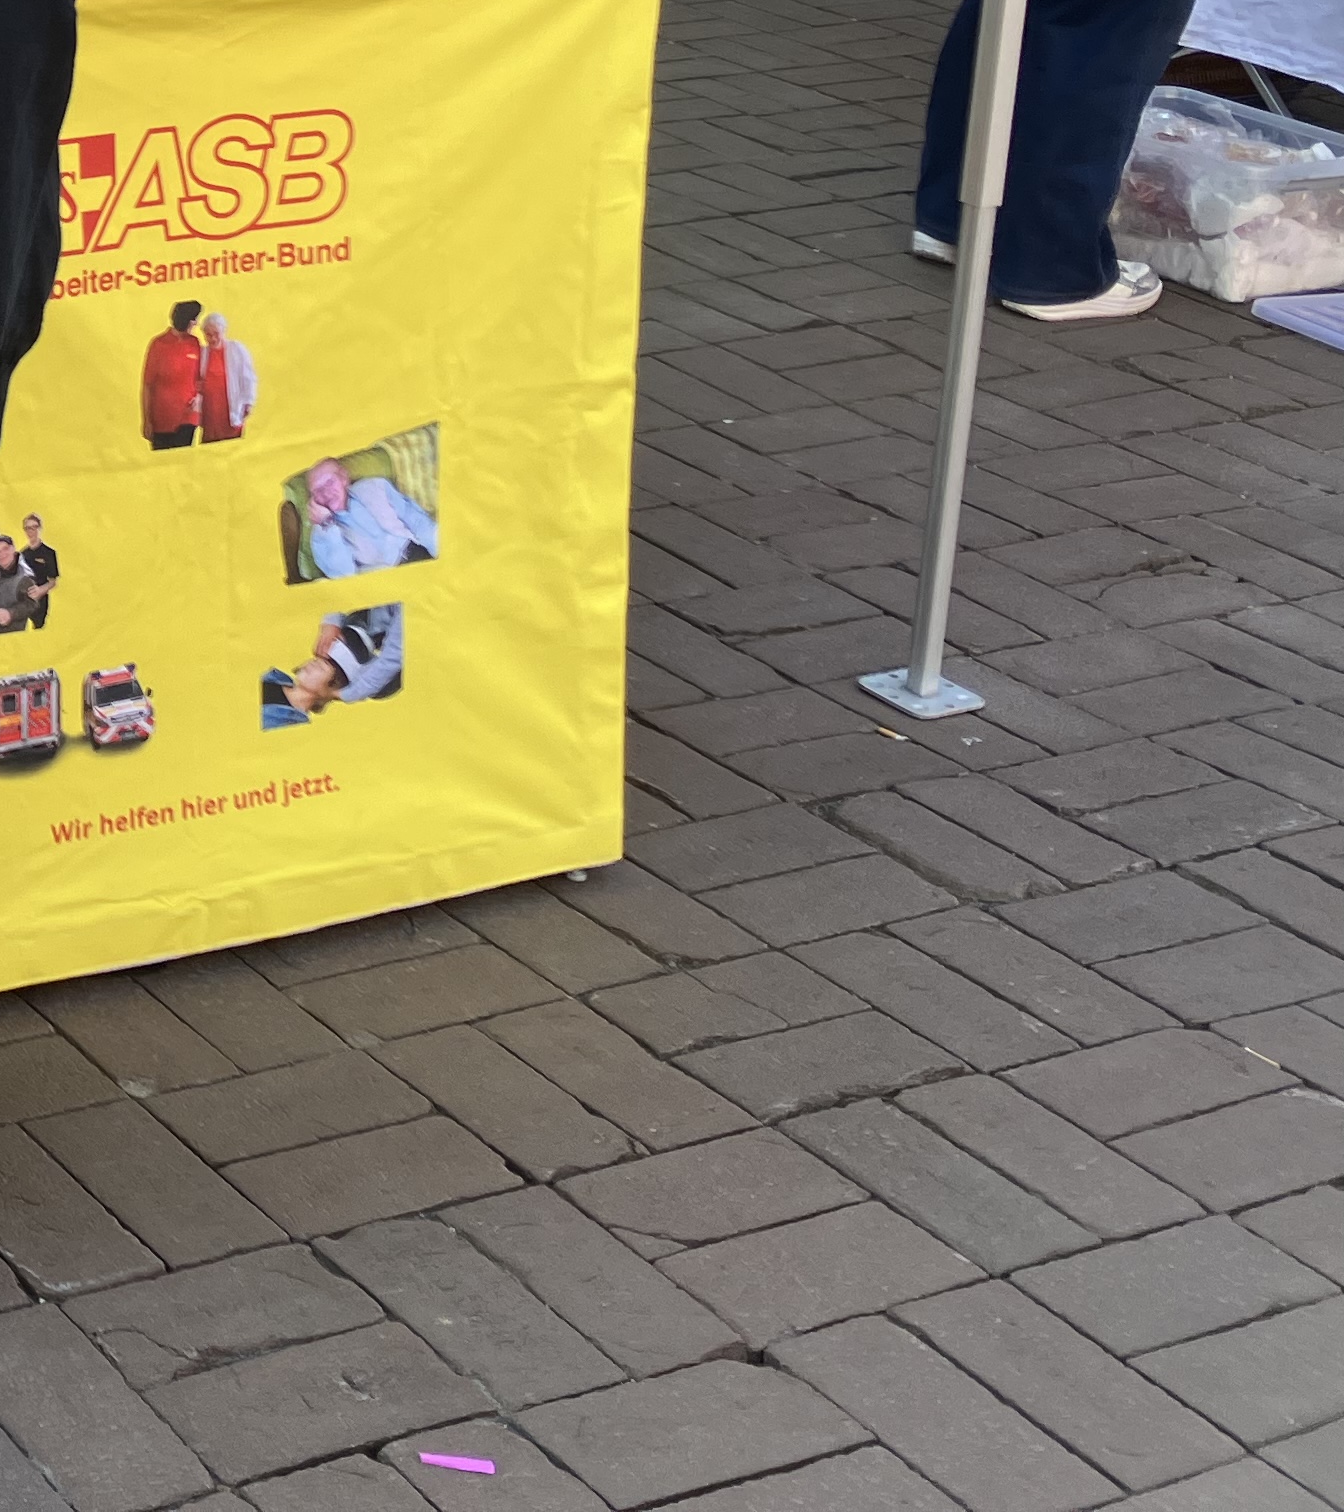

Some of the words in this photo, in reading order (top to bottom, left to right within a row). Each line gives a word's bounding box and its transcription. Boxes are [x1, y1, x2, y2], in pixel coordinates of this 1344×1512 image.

[88, 108, 355, 254] ASB
[50, 236, 352, 300] beiter-Samariter-Bund
[50, 817, 93, 844] Wir
[99, 805, 175, 836] helfen
[180, 795, 229, 821] hier
[232, 780, 277, 811] und
[280, 773, 341, 808] jetzt.
